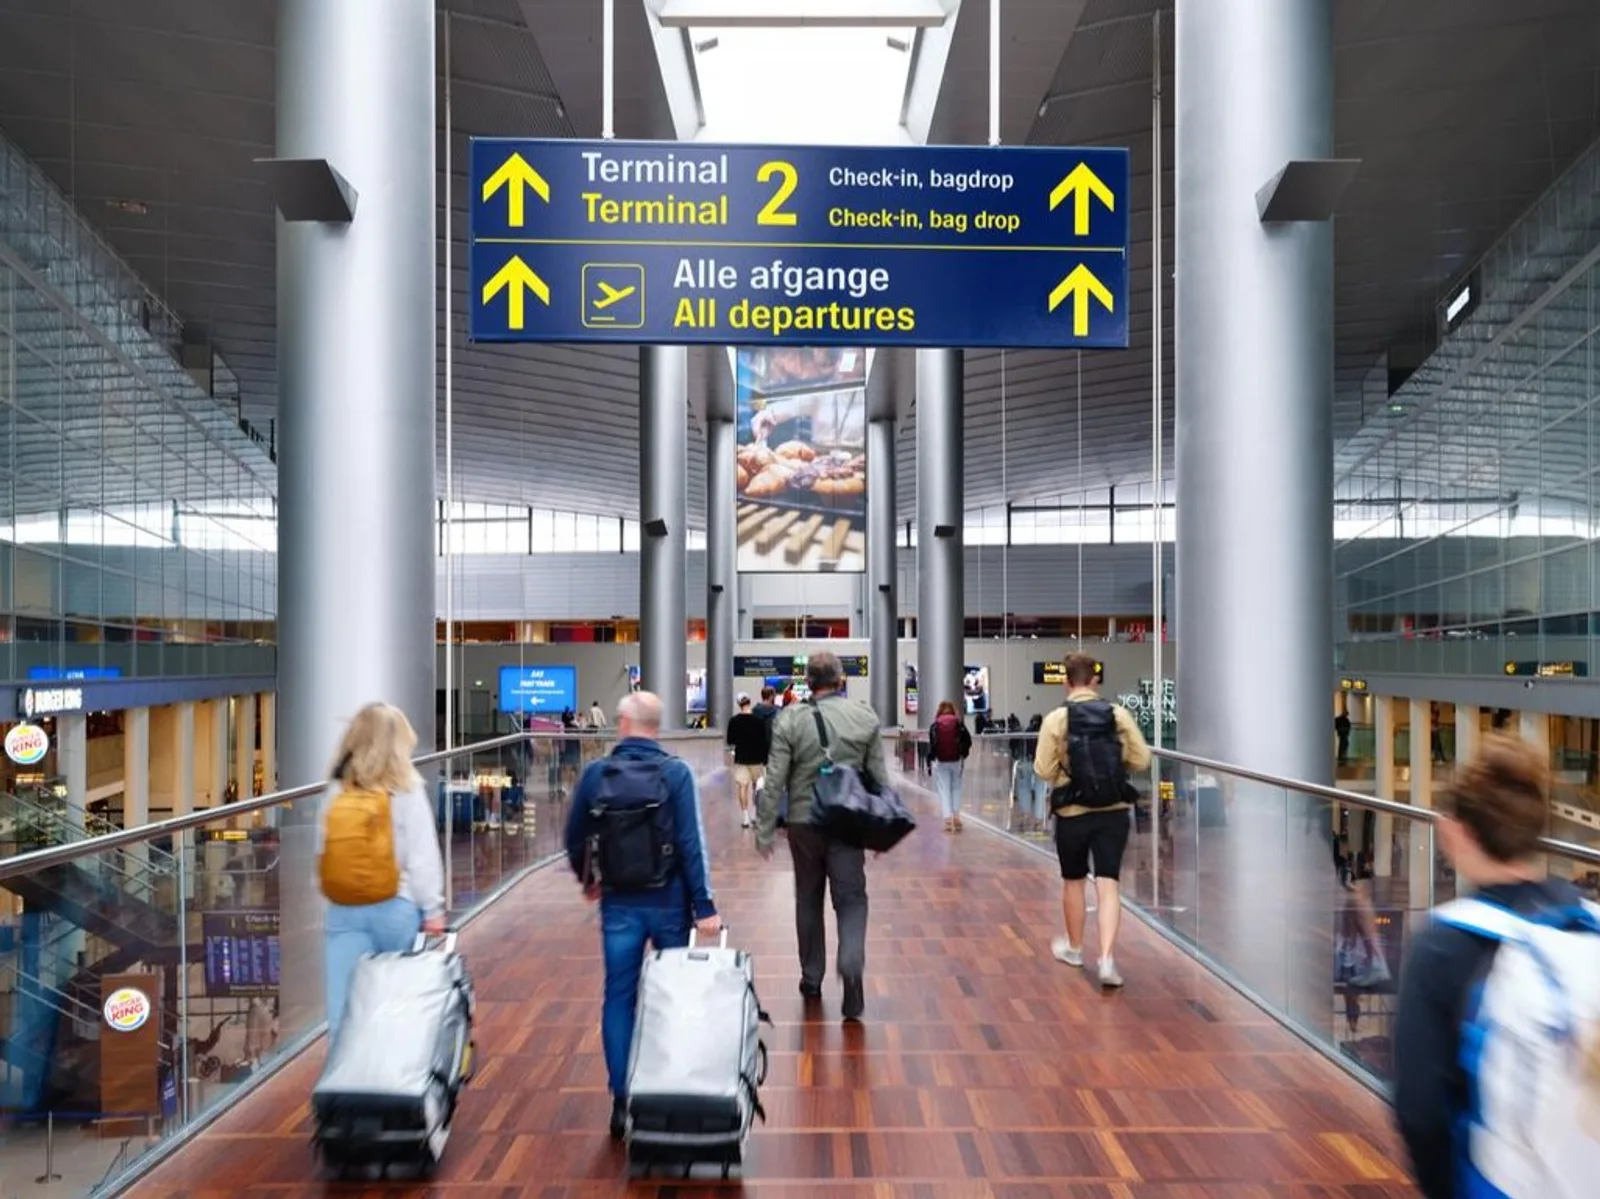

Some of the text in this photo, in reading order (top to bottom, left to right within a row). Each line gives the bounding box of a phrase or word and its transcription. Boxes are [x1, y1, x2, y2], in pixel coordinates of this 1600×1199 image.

[581, 152, 728, 184] Terminal
[829, 167, 1014, 193] Check-in, bagdrop
[756, 160, 799, 226] 2
[581, 193, 728, 225] Terminal
[829, 207, 1020, 234] Check-in, bag drop
[673, 259, 889, 297] Alle afgange
[673, 298, 915, 335] All departures
[1141, 680, 1174, 695] TE
[12, 738, 42, 753] KING
[112, 1003, 143, 1021] KING
